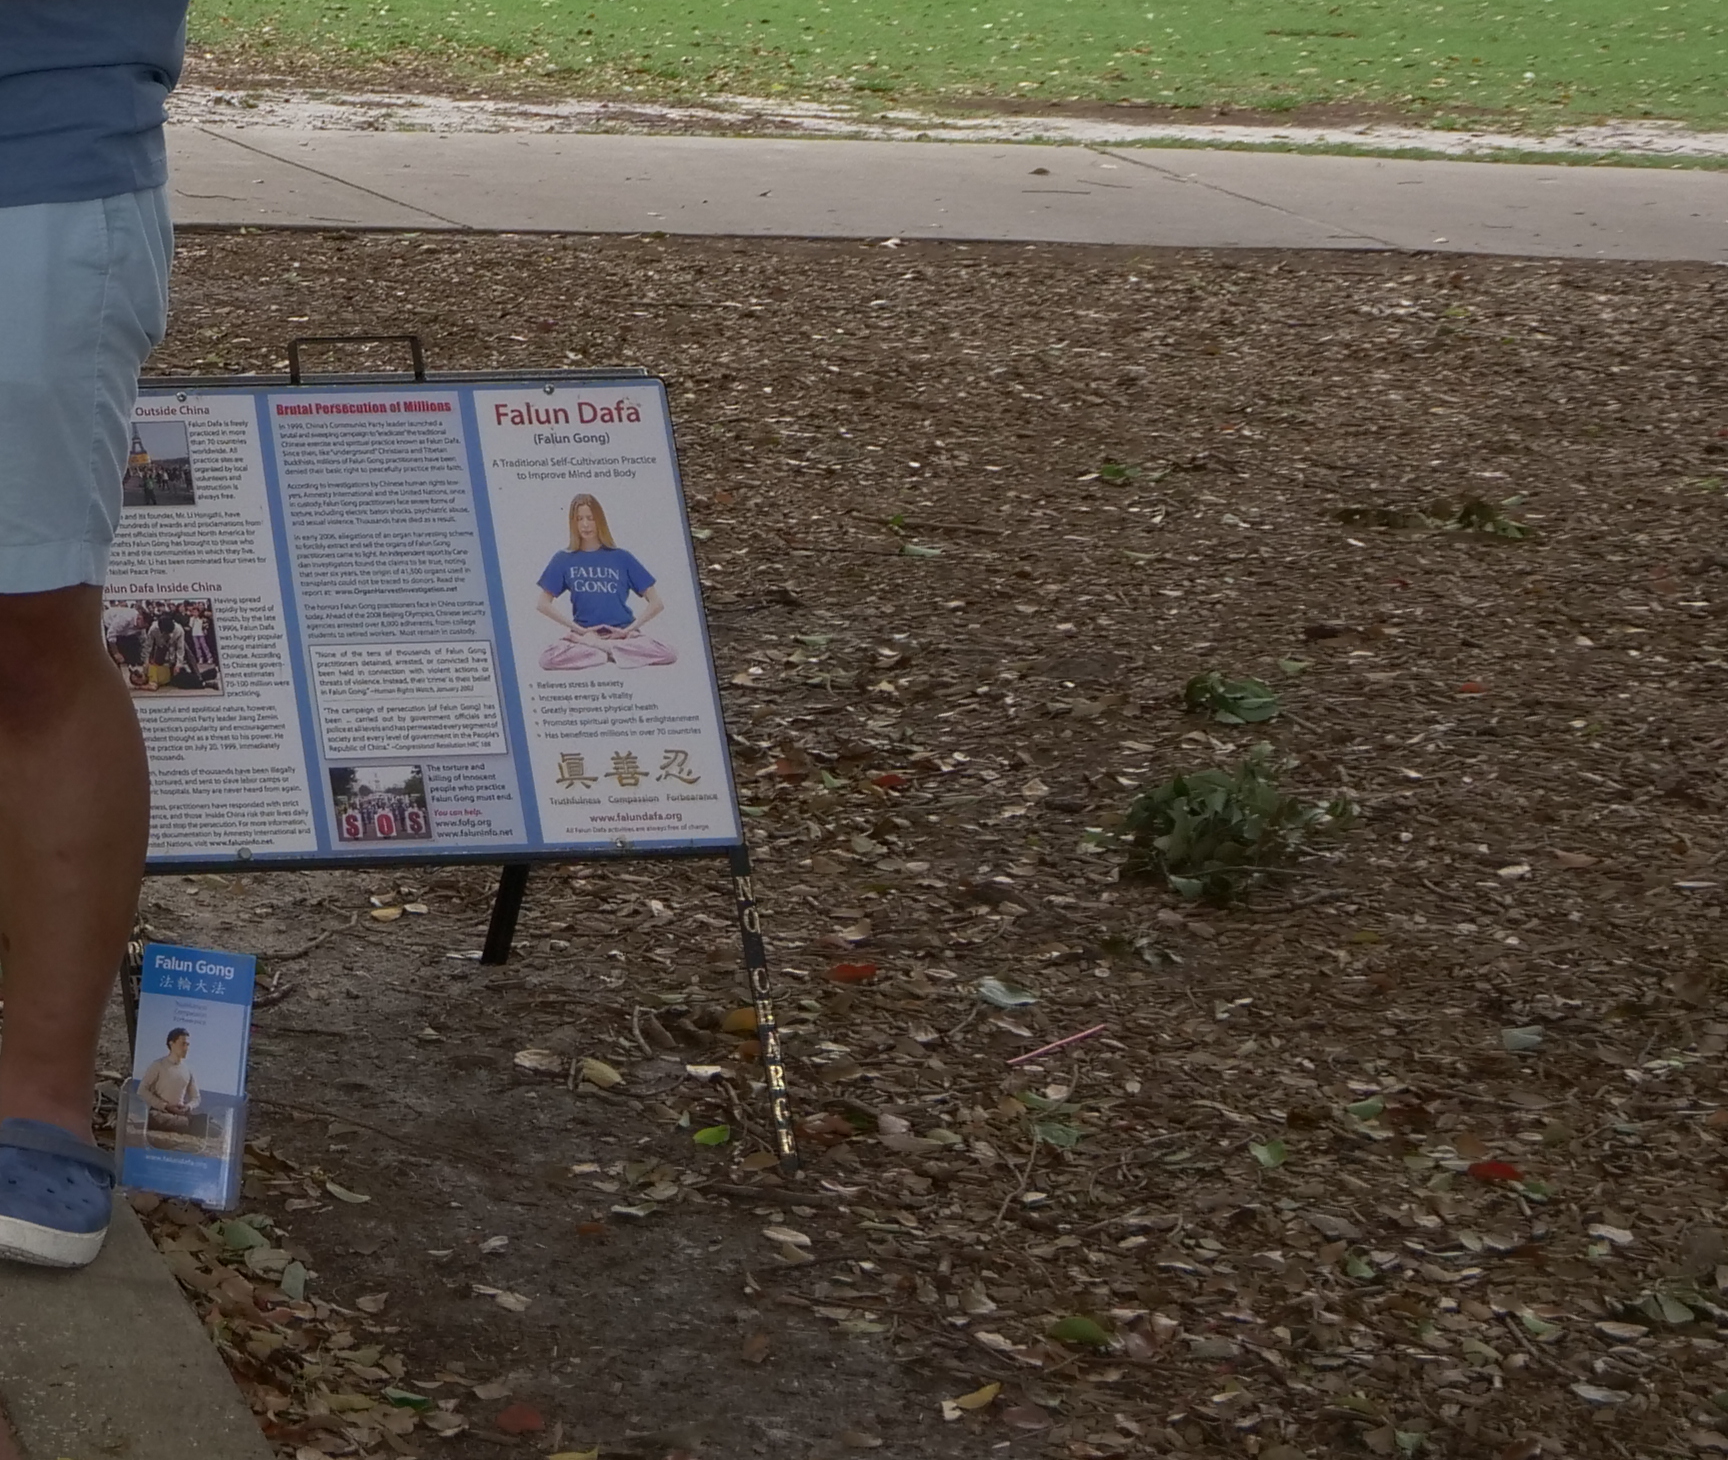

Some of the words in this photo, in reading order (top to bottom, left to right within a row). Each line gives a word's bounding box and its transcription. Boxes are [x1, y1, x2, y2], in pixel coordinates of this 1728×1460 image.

[136, 406, 177, 416] Outside
[179, 406, 209, 415] China
[276, 404, 312, 416] Brutal
[316, 402, 387, 415] Persecution
[390, 402, 401, 413] of
[404, 401, 452, 413] Millions
[495, 402, 569, 426] Falun
[577, 399, 641, 424] Dafa
[534, 433, 570, 446] (Falun
[573, 432, 610, 446] Gong)
[492, 460, 499, 468] A
[500, 458, 548, 468] Traditional
[622, 455, 656, 465] Practice
[529, 470, 566, 481] Improve
[569, 469, 592, 479] Mind
[594, 469, 611, 478] and
[614, 468, 636, 479] Body
[570, 566, 619, 580] FALUN
[105, 583, 127, 593] alun
[130, 583, 154, 593] Dafa
[157, 583, 189, 592] Inside
[191, 582, 222, 592] China
[574, 580, 617, 593] GONG
[590, 812, 682, 822] www.falundafa.org
[155, 955, 192, 973] Falun
[195, 960, 234, 980] Gong
